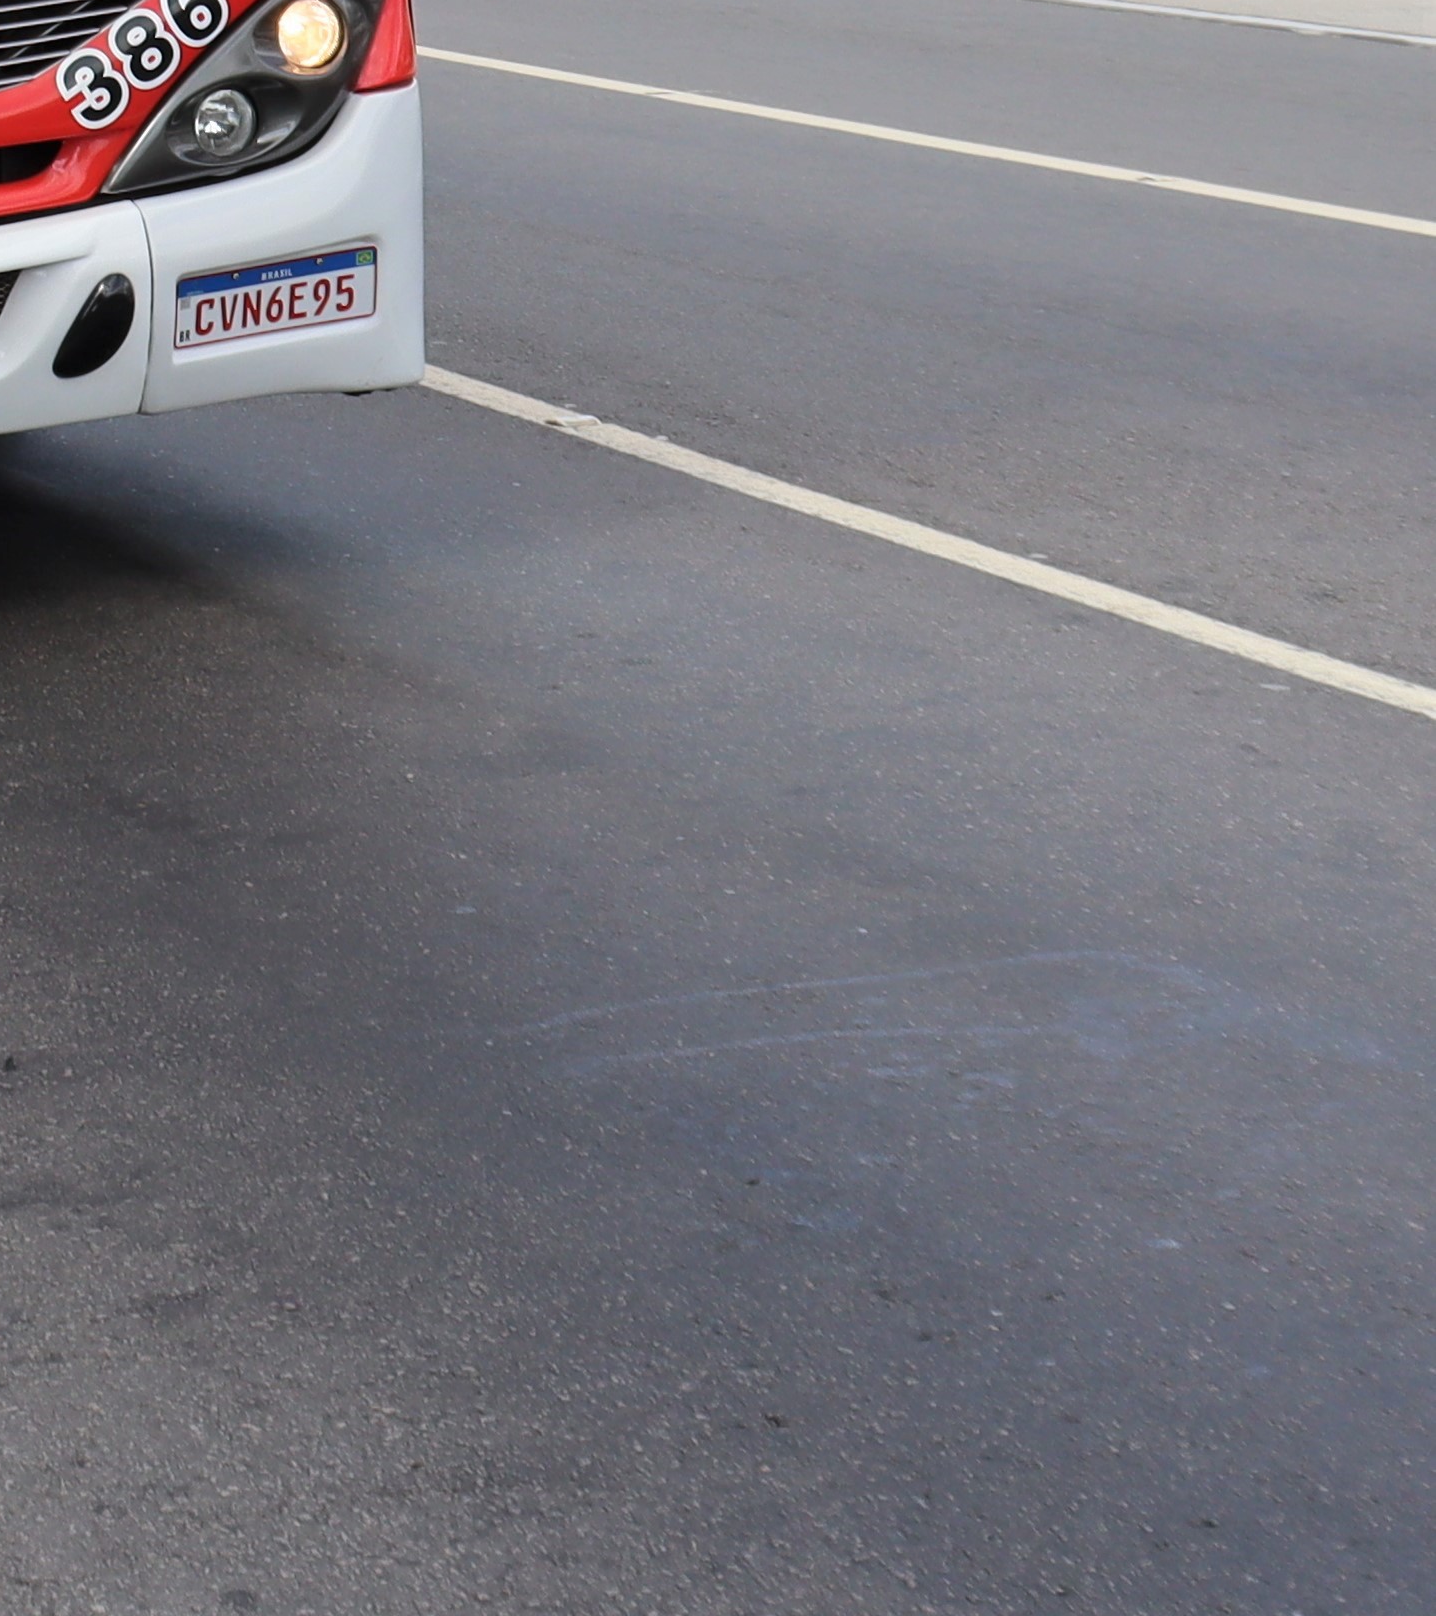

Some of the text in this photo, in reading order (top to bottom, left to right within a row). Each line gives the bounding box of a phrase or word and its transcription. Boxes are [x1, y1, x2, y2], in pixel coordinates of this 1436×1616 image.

[261, 268, 293, 282] BRASIL
[195, 273, 355, 337] CVN6E95
[179, 329, 191, 343] BR
